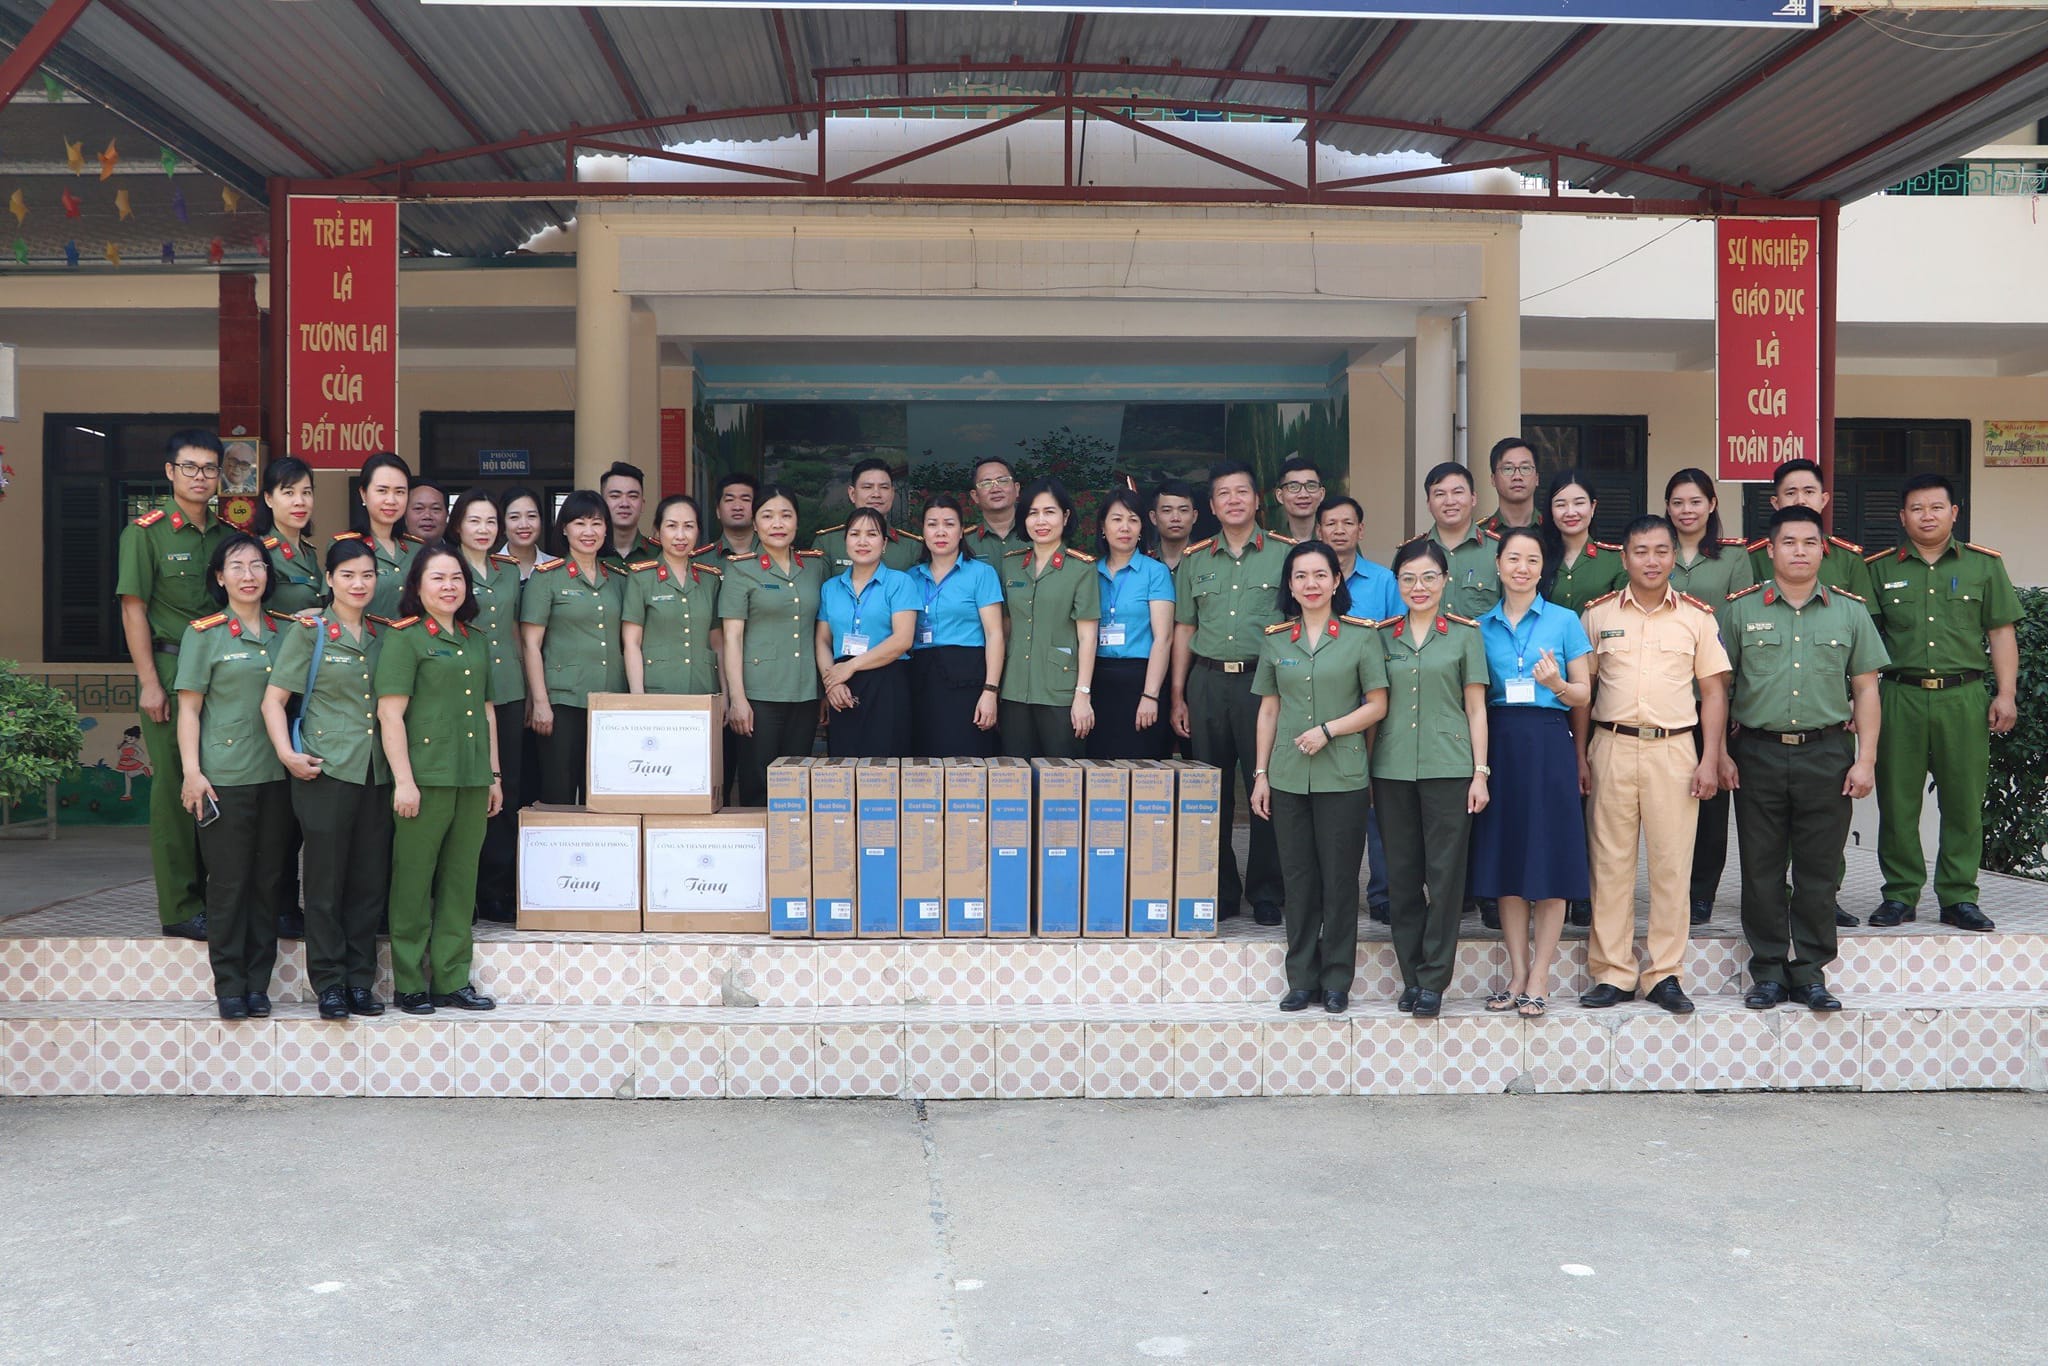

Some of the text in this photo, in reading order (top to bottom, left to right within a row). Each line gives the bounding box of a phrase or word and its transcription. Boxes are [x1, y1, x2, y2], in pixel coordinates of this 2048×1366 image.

[313, 210, 373, 249] TRẺ EM
[1728, 233, 1809, 272] SỰ NGHIỆP
[333, 265, 353, 303] LÀ
[1732, 282, 1805, 322] GIÁO DỤC
[300, 321, 388, 355] TƯƠNG LAI
[1756, 331, 1780, 368] LÀ
[321, 364, 363, 405] CỦA
[1748, 379, 1787, 418] CỦA
[301, 412, 384, 453] ĐẤT NƯỚC
[1727, 429, 1804, 465] TOÀN DÂN
[628, 760, 672, 777] Tặng
[556, 875, 601, 893] Tặng
[684, 877, 728, 894] Tặng
